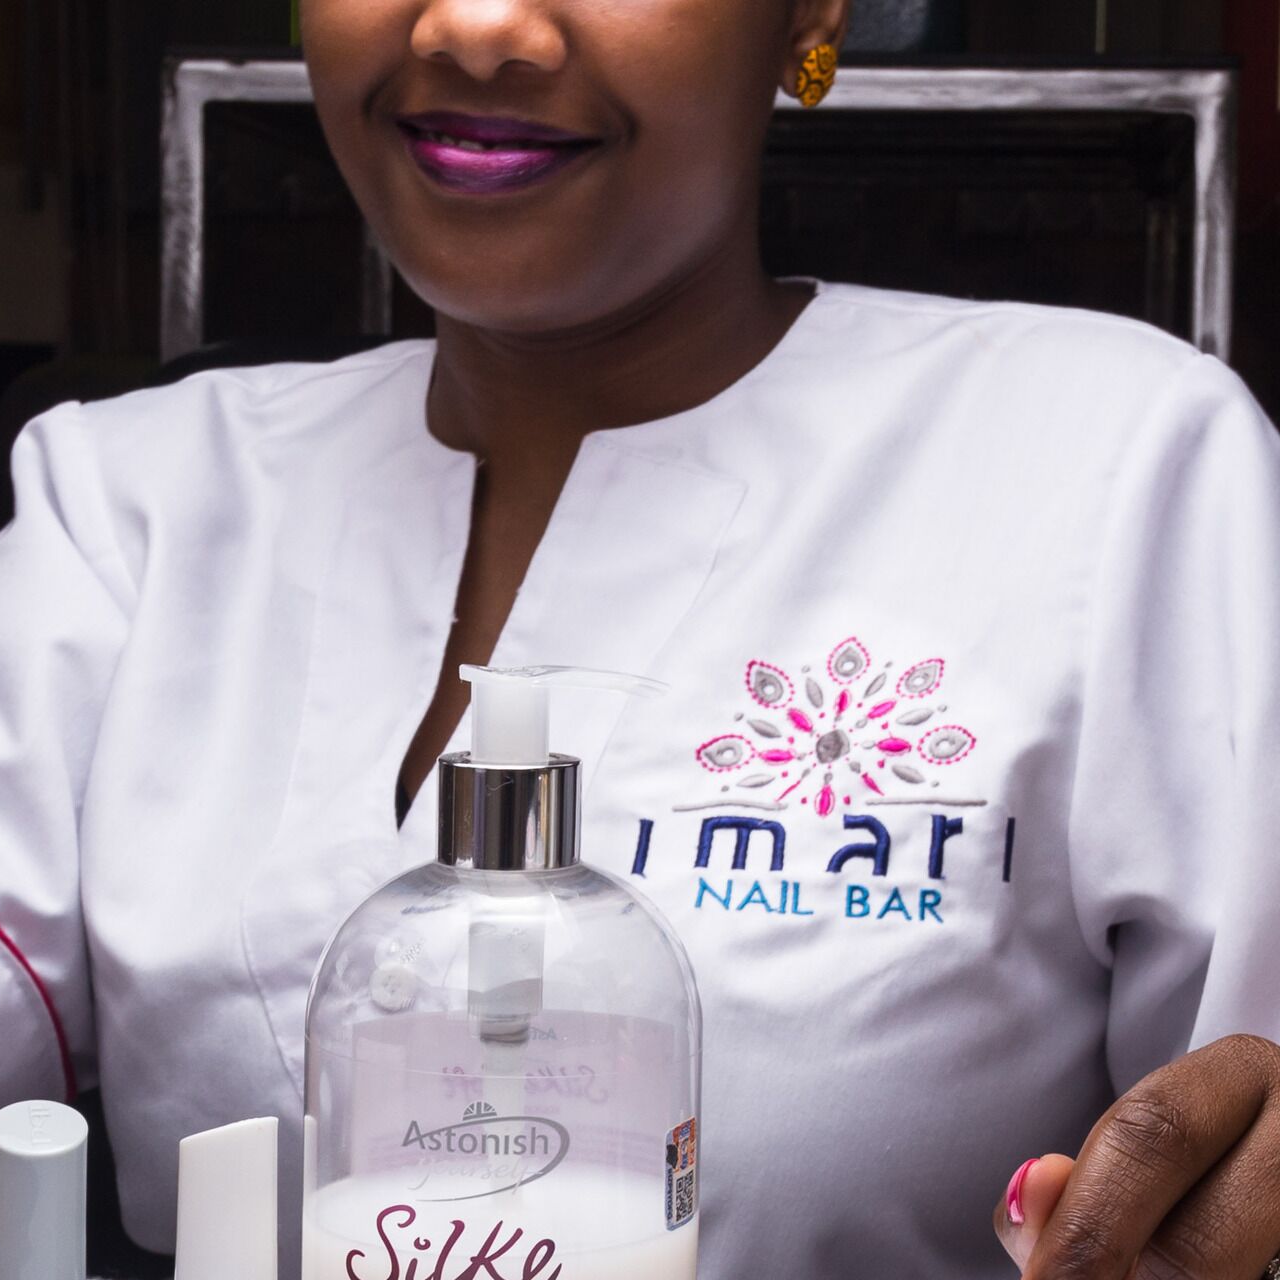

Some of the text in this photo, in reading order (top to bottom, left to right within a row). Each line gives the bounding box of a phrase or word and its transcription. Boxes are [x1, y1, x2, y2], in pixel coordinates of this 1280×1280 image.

[694, 878, 944, 924] NAIL BAR
[401, 1120, 549, 1155] Astonish
